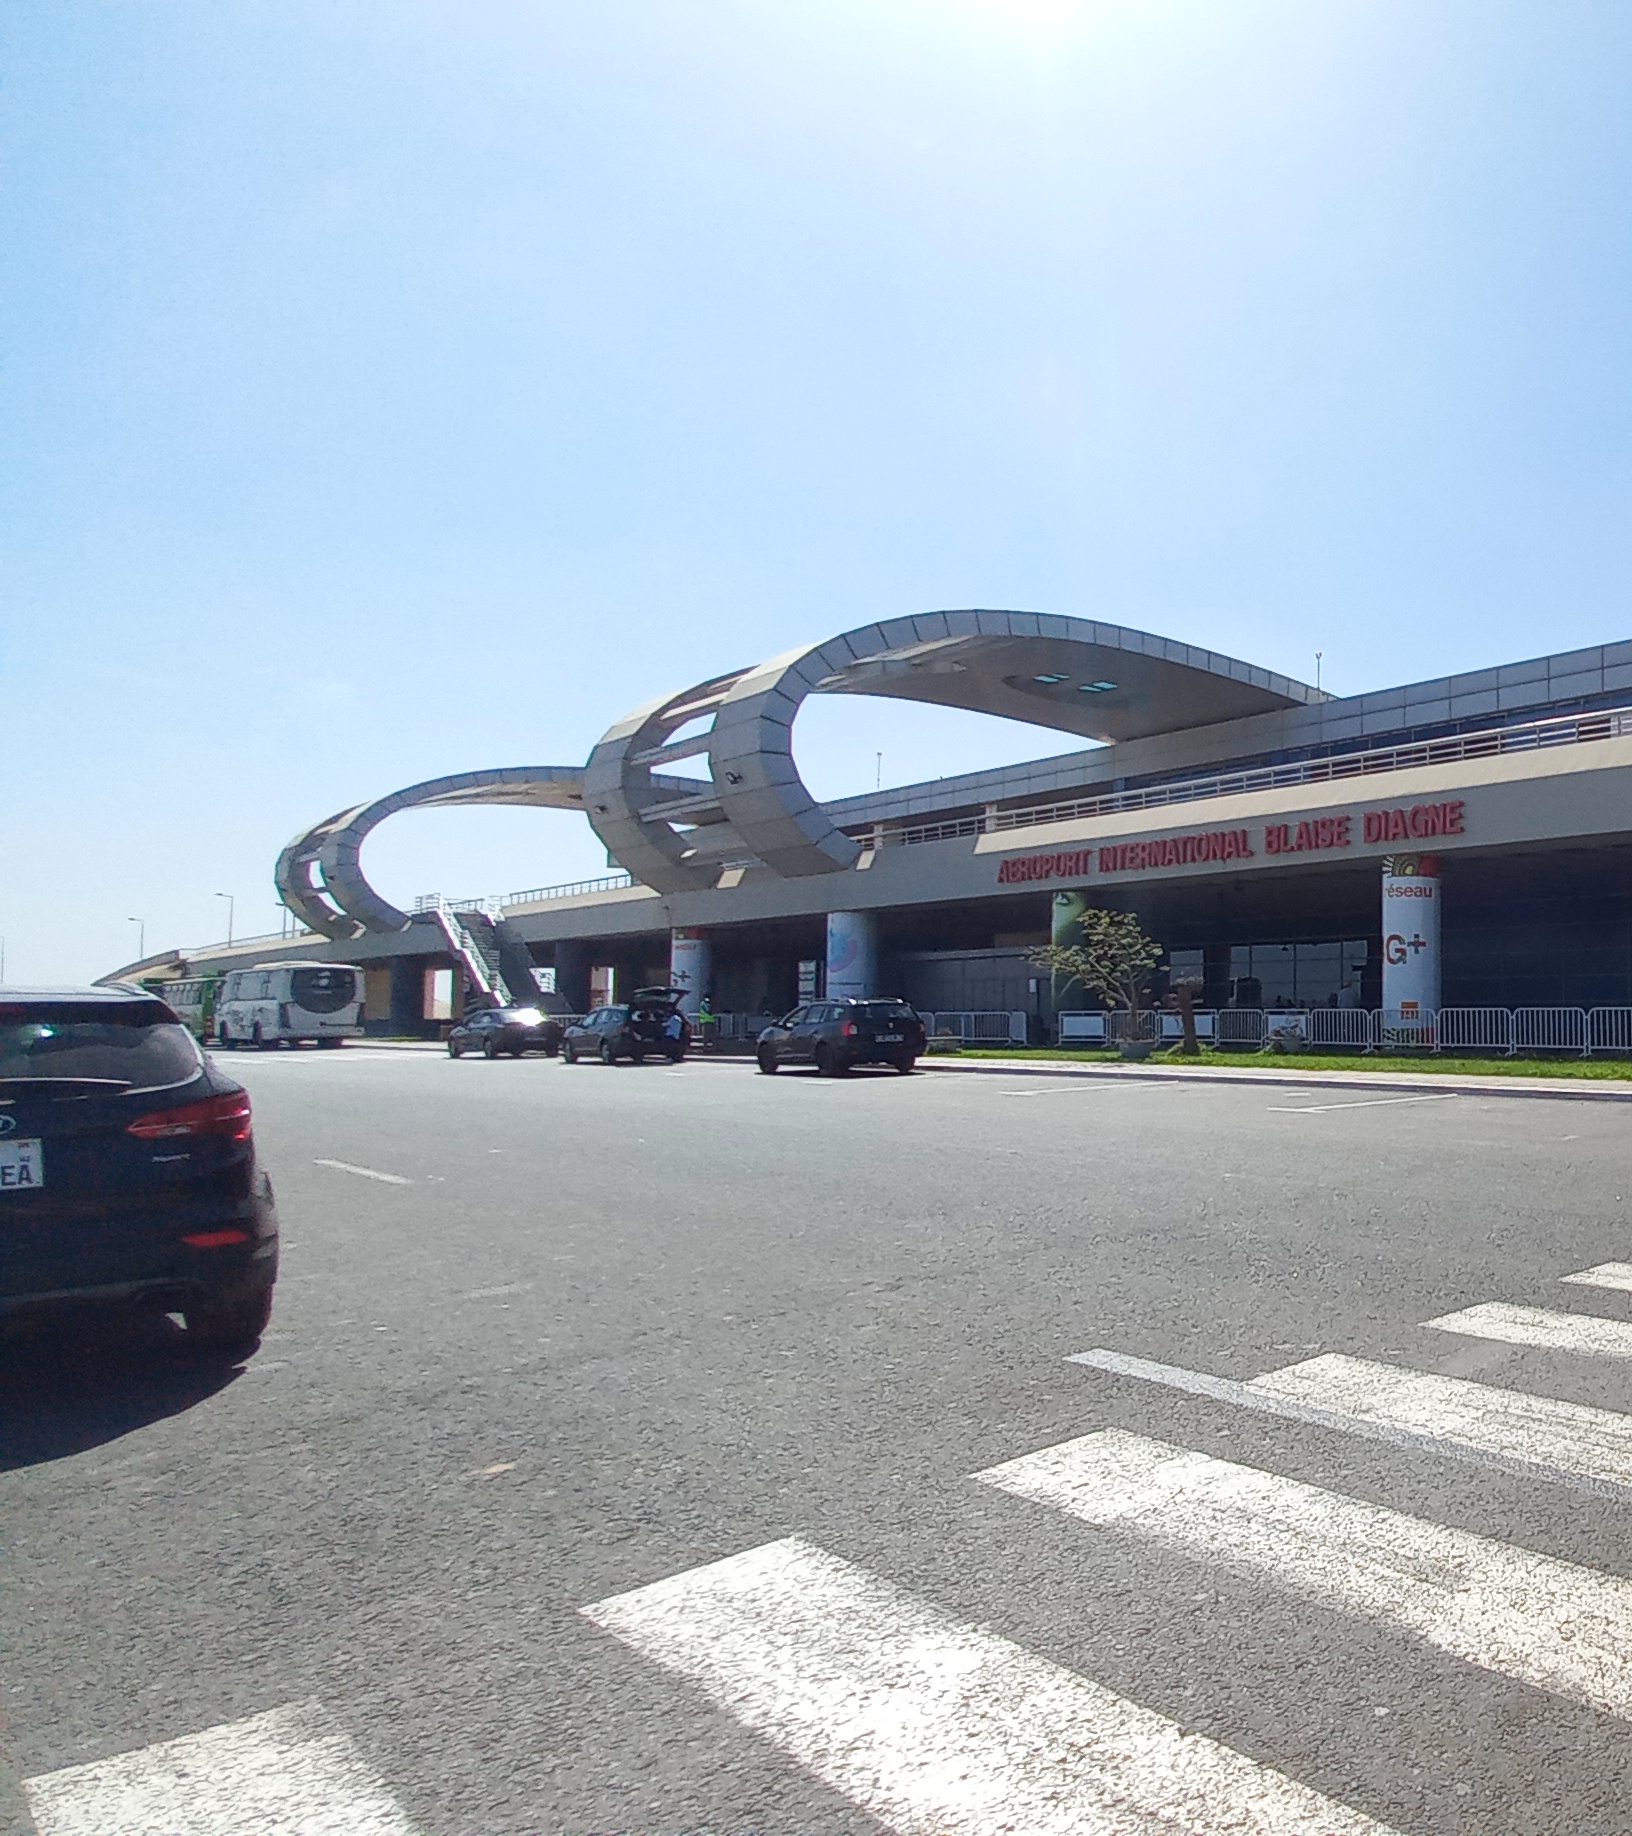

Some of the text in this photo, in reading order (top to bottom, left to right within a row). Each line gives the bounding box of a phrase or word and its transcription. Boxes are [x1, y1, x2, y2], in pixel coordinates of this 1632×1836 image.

[997, 800, 1466, 883] AEROPORT INTERNATIONAL BLAISE DIAGNE
